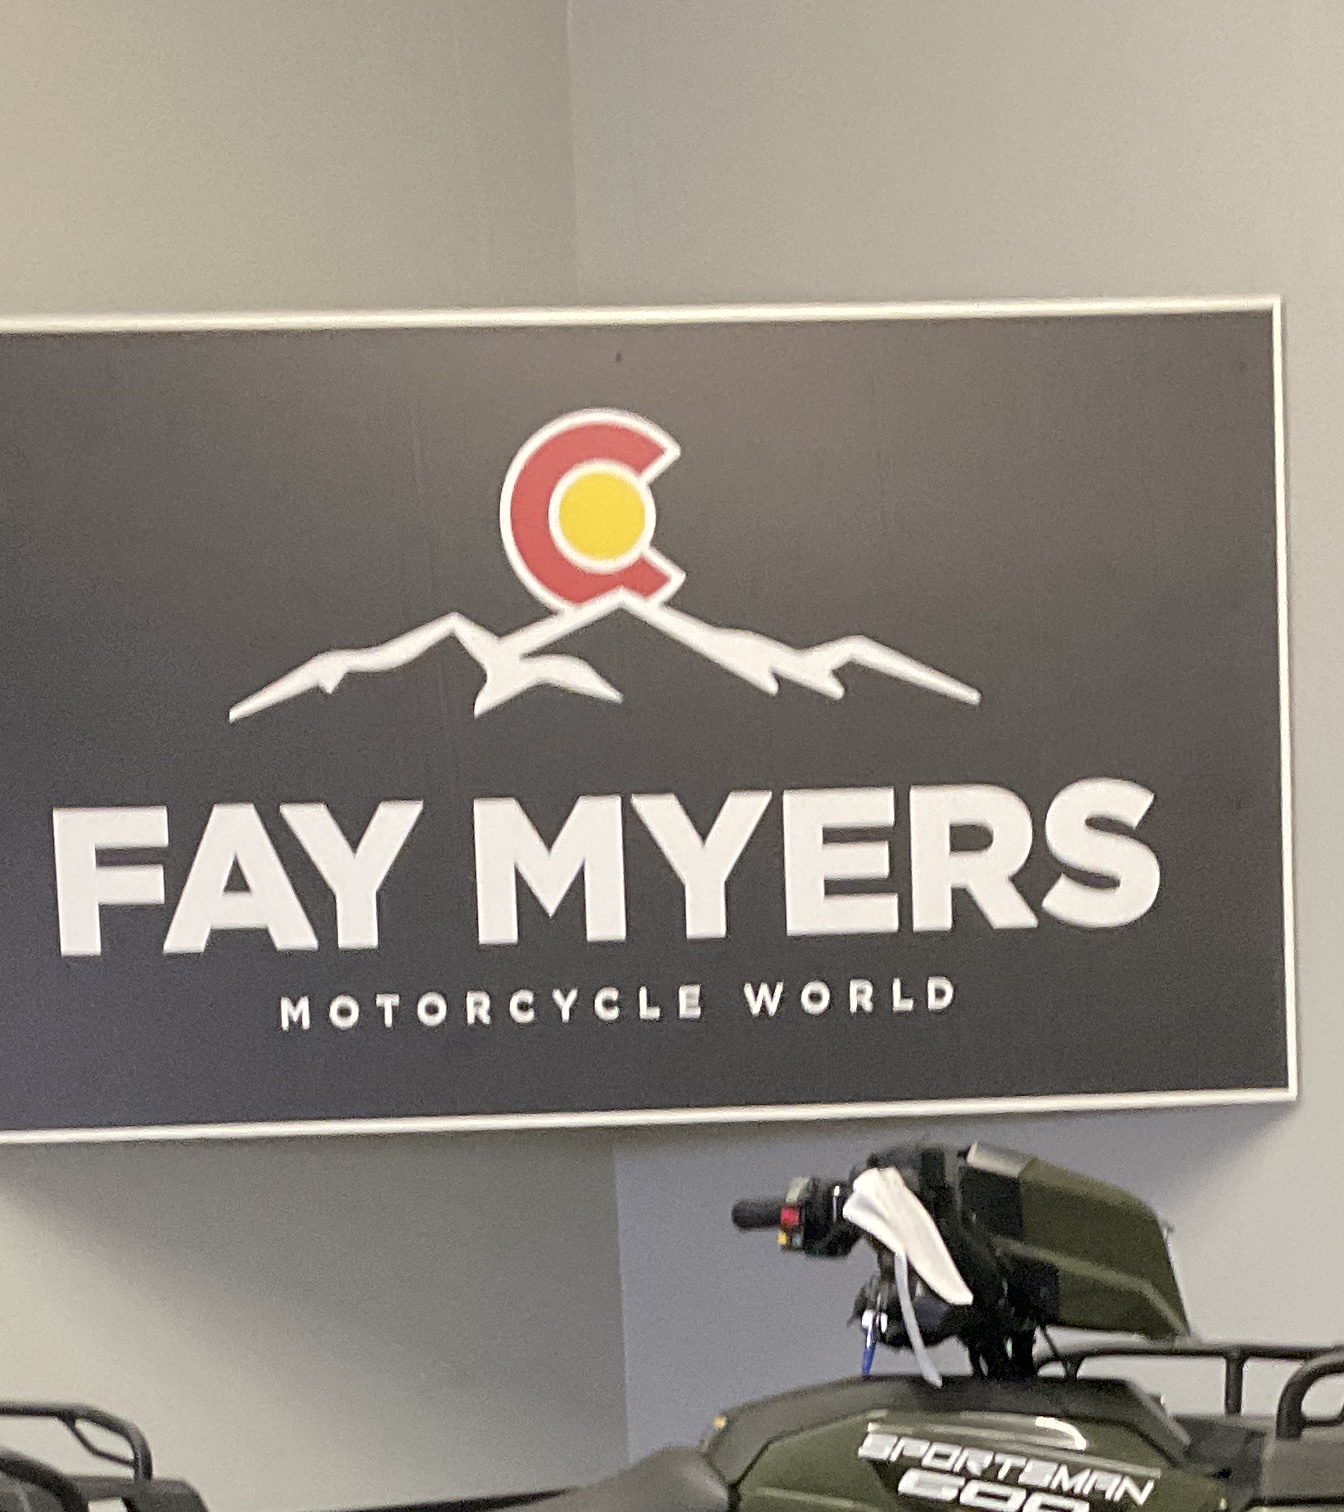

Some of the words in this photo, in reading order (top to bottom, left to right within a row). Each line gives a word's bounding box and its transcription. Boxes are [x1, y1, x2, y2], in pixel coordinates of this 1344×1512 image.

[53, 801, 423, 956] FAY
[474, 778, 1160, 944] MYERS
[281, 985, 701, 1030] MOTORCYCLE
[744, 977, 953, 1016] WORLD
[858, 1433, 1154, 1506] SPORTSMAN
